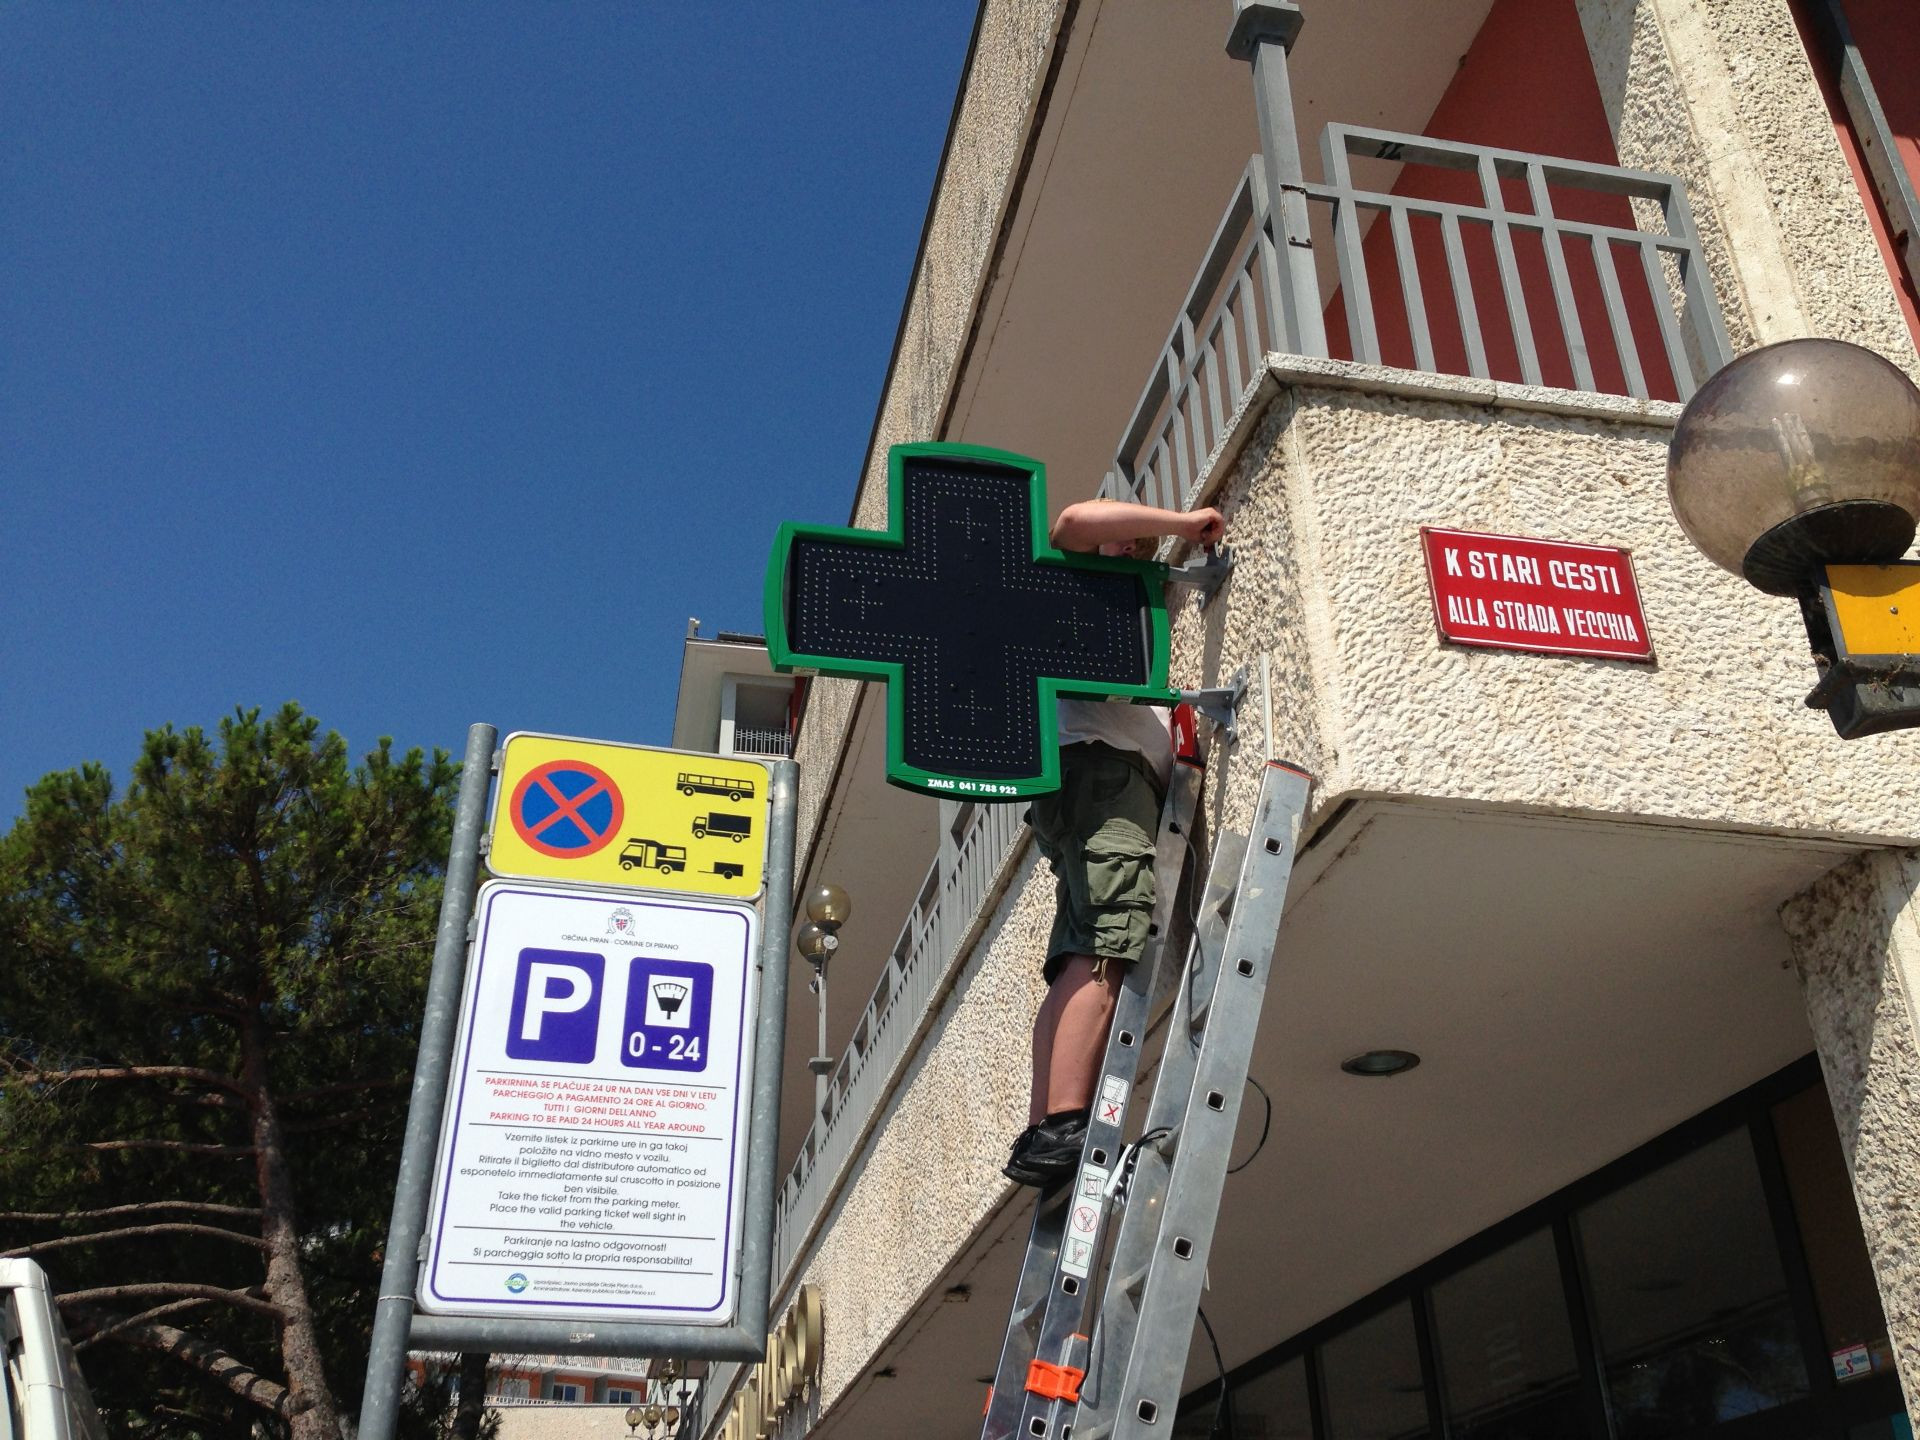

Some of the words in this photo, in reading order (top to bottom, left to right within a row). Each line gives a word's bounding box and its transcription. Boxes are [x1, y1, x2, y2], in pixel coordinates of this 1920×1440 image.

[1445, 548, 1462, 577] K
[1468, 550, 1542, 586] STARI
[1549, 560, 1620, 595] CESTI
[1448, 595, 1490, 626] ALLA
[1493, 600, 1561, 634] STRADA
[1563, 608, 1639, 642] VECCHIA
[928, 779, 954, 788] ZMAS
[959, 782, 976, 790] 041
[999, 786, 1017, 794] 922
[561, 934, 588, 942] OBČINA
[614, 939, 644, 947] COMUNE
[521, 962, 592, 1040] P
[629, 1032, 646, 1056] 0
[668, 1034, 700, 1062] 24
[485, 1077, 538, 1088] PARKIRNINA
[540, 1080, 550, 1088] SE
[553, 1080, 590, 1091] PLAČUJE
[620, 1086, 632, 1094] NA
[634, 1088, 653, 1096] DAN
[698, 1092, 716, 1100] LETU
[493, 1089, 554, 1100] PARCHEGGIO
[566, 1094, 620, 1104] PAGAMENTO
[636, 1098, 654, 1106] ORE
[574, 1106, 606, 1114] GIORNI
[490, 1112, 529, 1121] PARKING
[594, 1118, 624, 1127] HOURS
[644, 1122, 666, 1130] YEAR
[668, 1124, 705, 1132] AROUND
[505, 1132, 542, 1142] Vzemite
[545, 1135, 568, 1144] listek
[571, 1136, 578, 1144] iz
[639, 1140, 647, 1148] in
[650, 1143, 662, 1151] ga
[665, 1142, 688, 1152] takoj
[520, 1146, 557, 1156] položite
[576, 1150, 602, 1158] vidno
[604, 1151, 633, 1160] mesto
[479, 1155, 511, 1164] Ritirate
[514, 1156, 520, 1165] il
[522, 1158, 560, 1168] biglietto
[564, 1160, 579, 1168] dal
[582, 1161, 634, 1172] distributore
[637, 1165, 691, 1175] automatico
[460, 1168, 516, 1177] esponetelo
[519, 1170, 602, 1182] immediatamente
[620, 1176, 664, 1185] cruscotto
[678, 1180, 720, 1188] posizione
[564, 1185, 582, 1194] ben
[498, 1192, 520, 1200] Take
[524, 1193, 538, 1201] the
[542, 1194, 566, 1202] ticket
[570, 1195, 592, 1204] from
[612, 1198, 648, 1208] parking
[651, 1200, 680, 1208] meter.
[490, 1204, 517, 1212] Place
[520, 1205, 536, 1213] the
[538, 1206, 562, 1214] valid
[564, 1208, 601, 1218] parking
[604, 1210, 630, 1218] ticket
[632, 1212, 650, 1220] well
[653, 1212, 675, 1222] sight
[560, 1220, 576, 1228] the
[504, 1236, 552, 1247] Parkiranje
[555, 1240, 568, 1248] na
[571, 1239, 600, 1248] lastno
[472, 1248, 481, 1256] Si
[484, 1248, 543, 1260] parcheggia
[546, 1251, 570, 1260] sotto
[572, 1252, 582, 1261] la
[584, 1254, 620, 1264] propria
